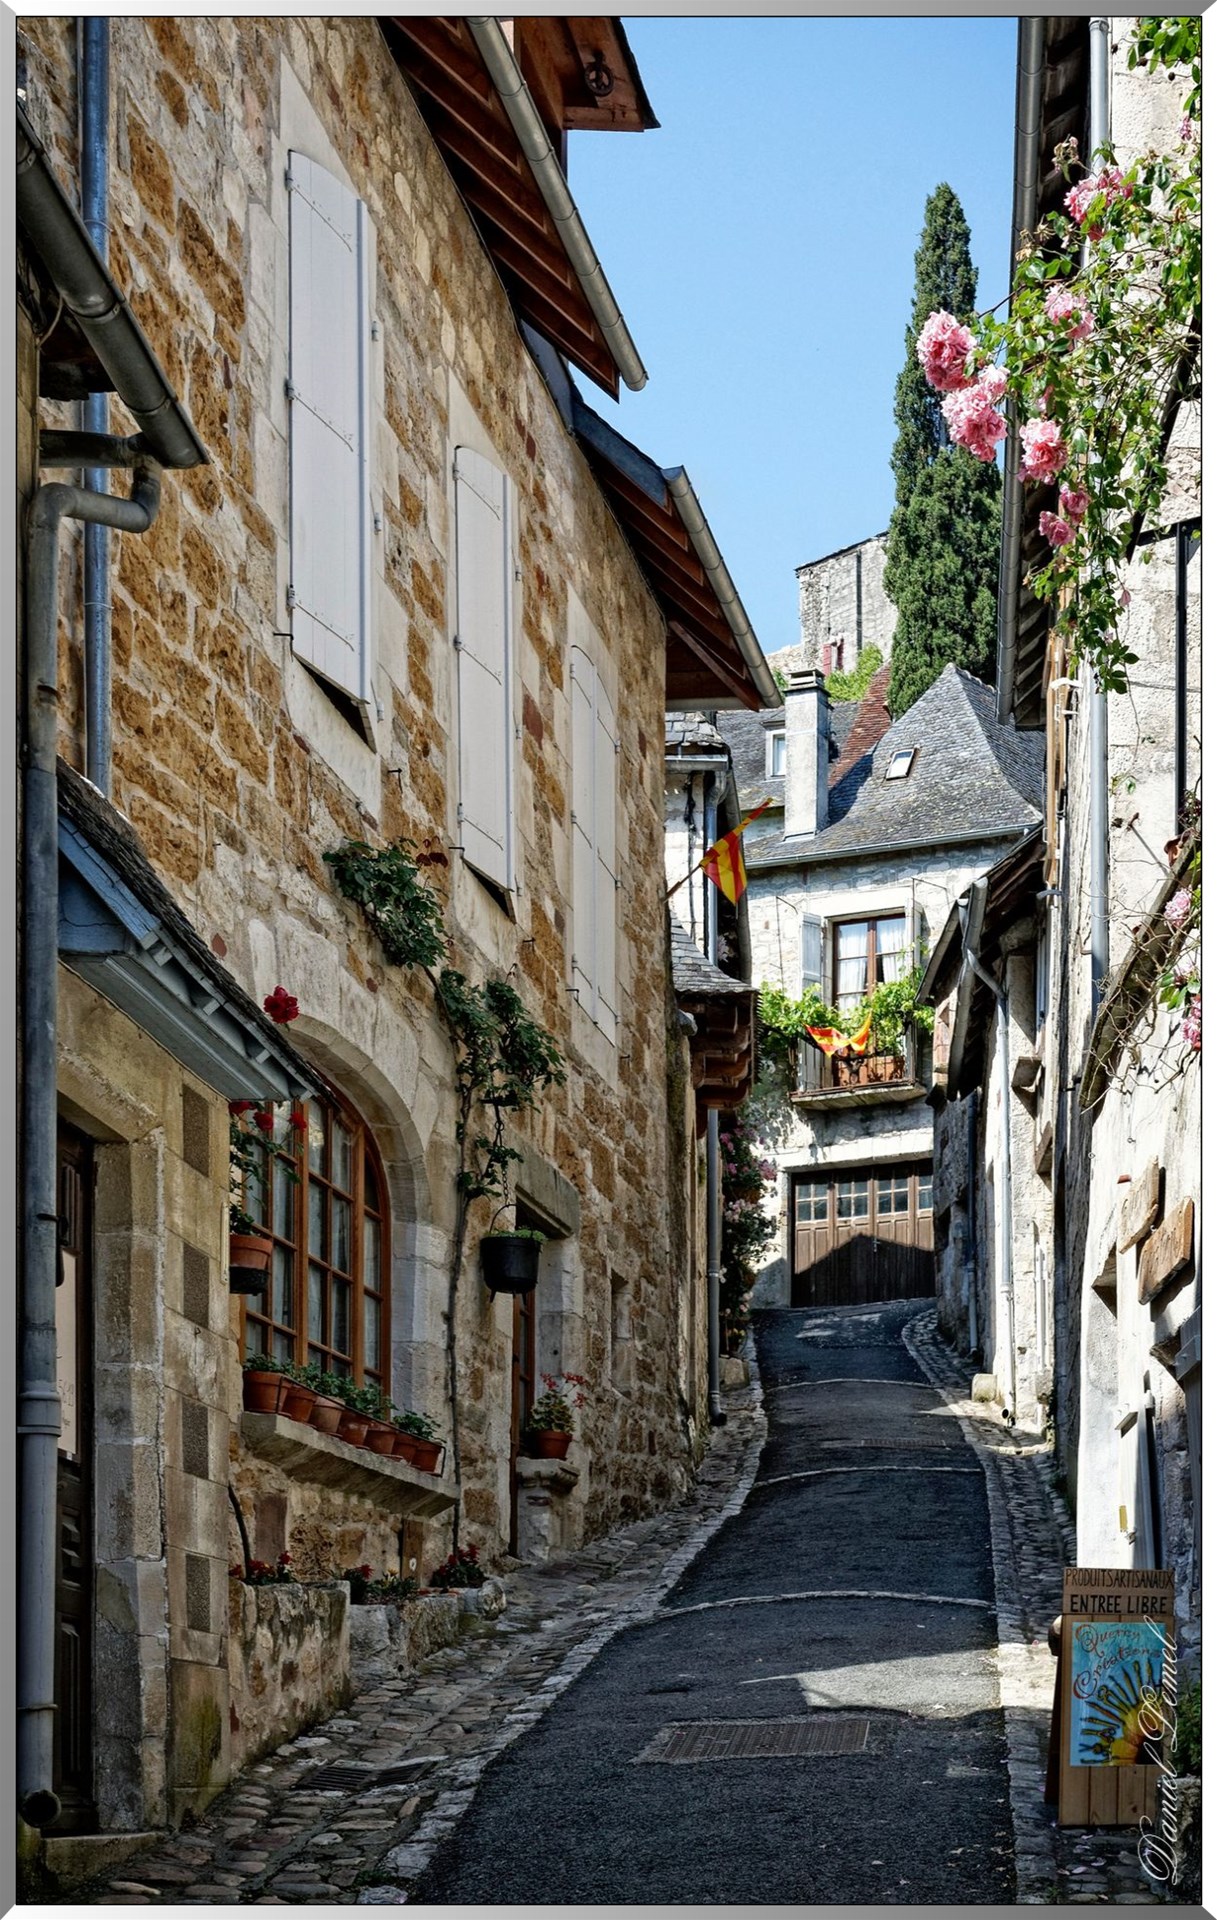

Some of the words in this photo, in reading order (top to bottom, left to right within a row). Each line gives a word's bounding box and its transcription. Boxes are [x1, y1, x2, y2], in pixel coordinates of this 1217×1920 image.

[1065, 1568, 1113, 1588] PRODUITS
[1113, 1569, 1174, 1590] ARTISANAUX
[1070, 1594, 1122, 1613] ENTREE
[1127, 1595, 1168, 1614] LIBRE
